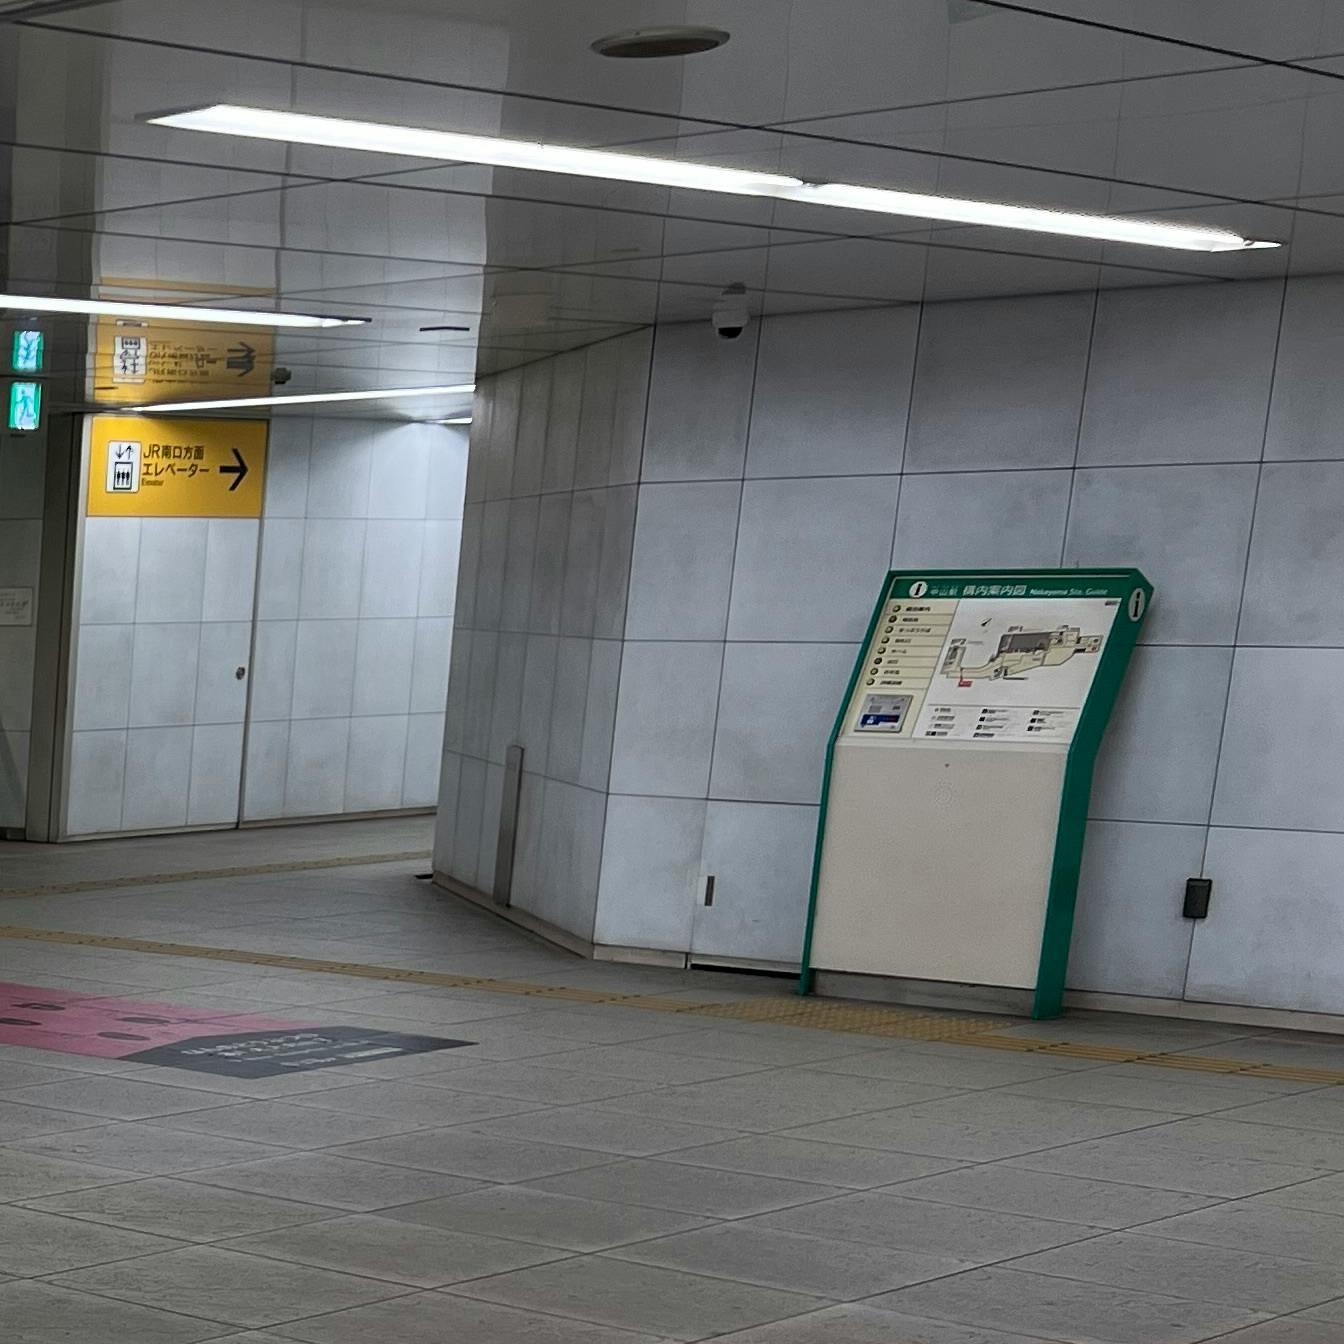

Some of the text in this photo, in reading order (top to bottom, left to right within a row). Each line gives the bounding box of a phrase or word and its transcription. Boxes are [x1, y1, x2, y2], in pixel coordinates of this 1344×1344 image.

[143, 444, 205, 460] JR南口方面
[142, 462, 209, 477] エレベーター
